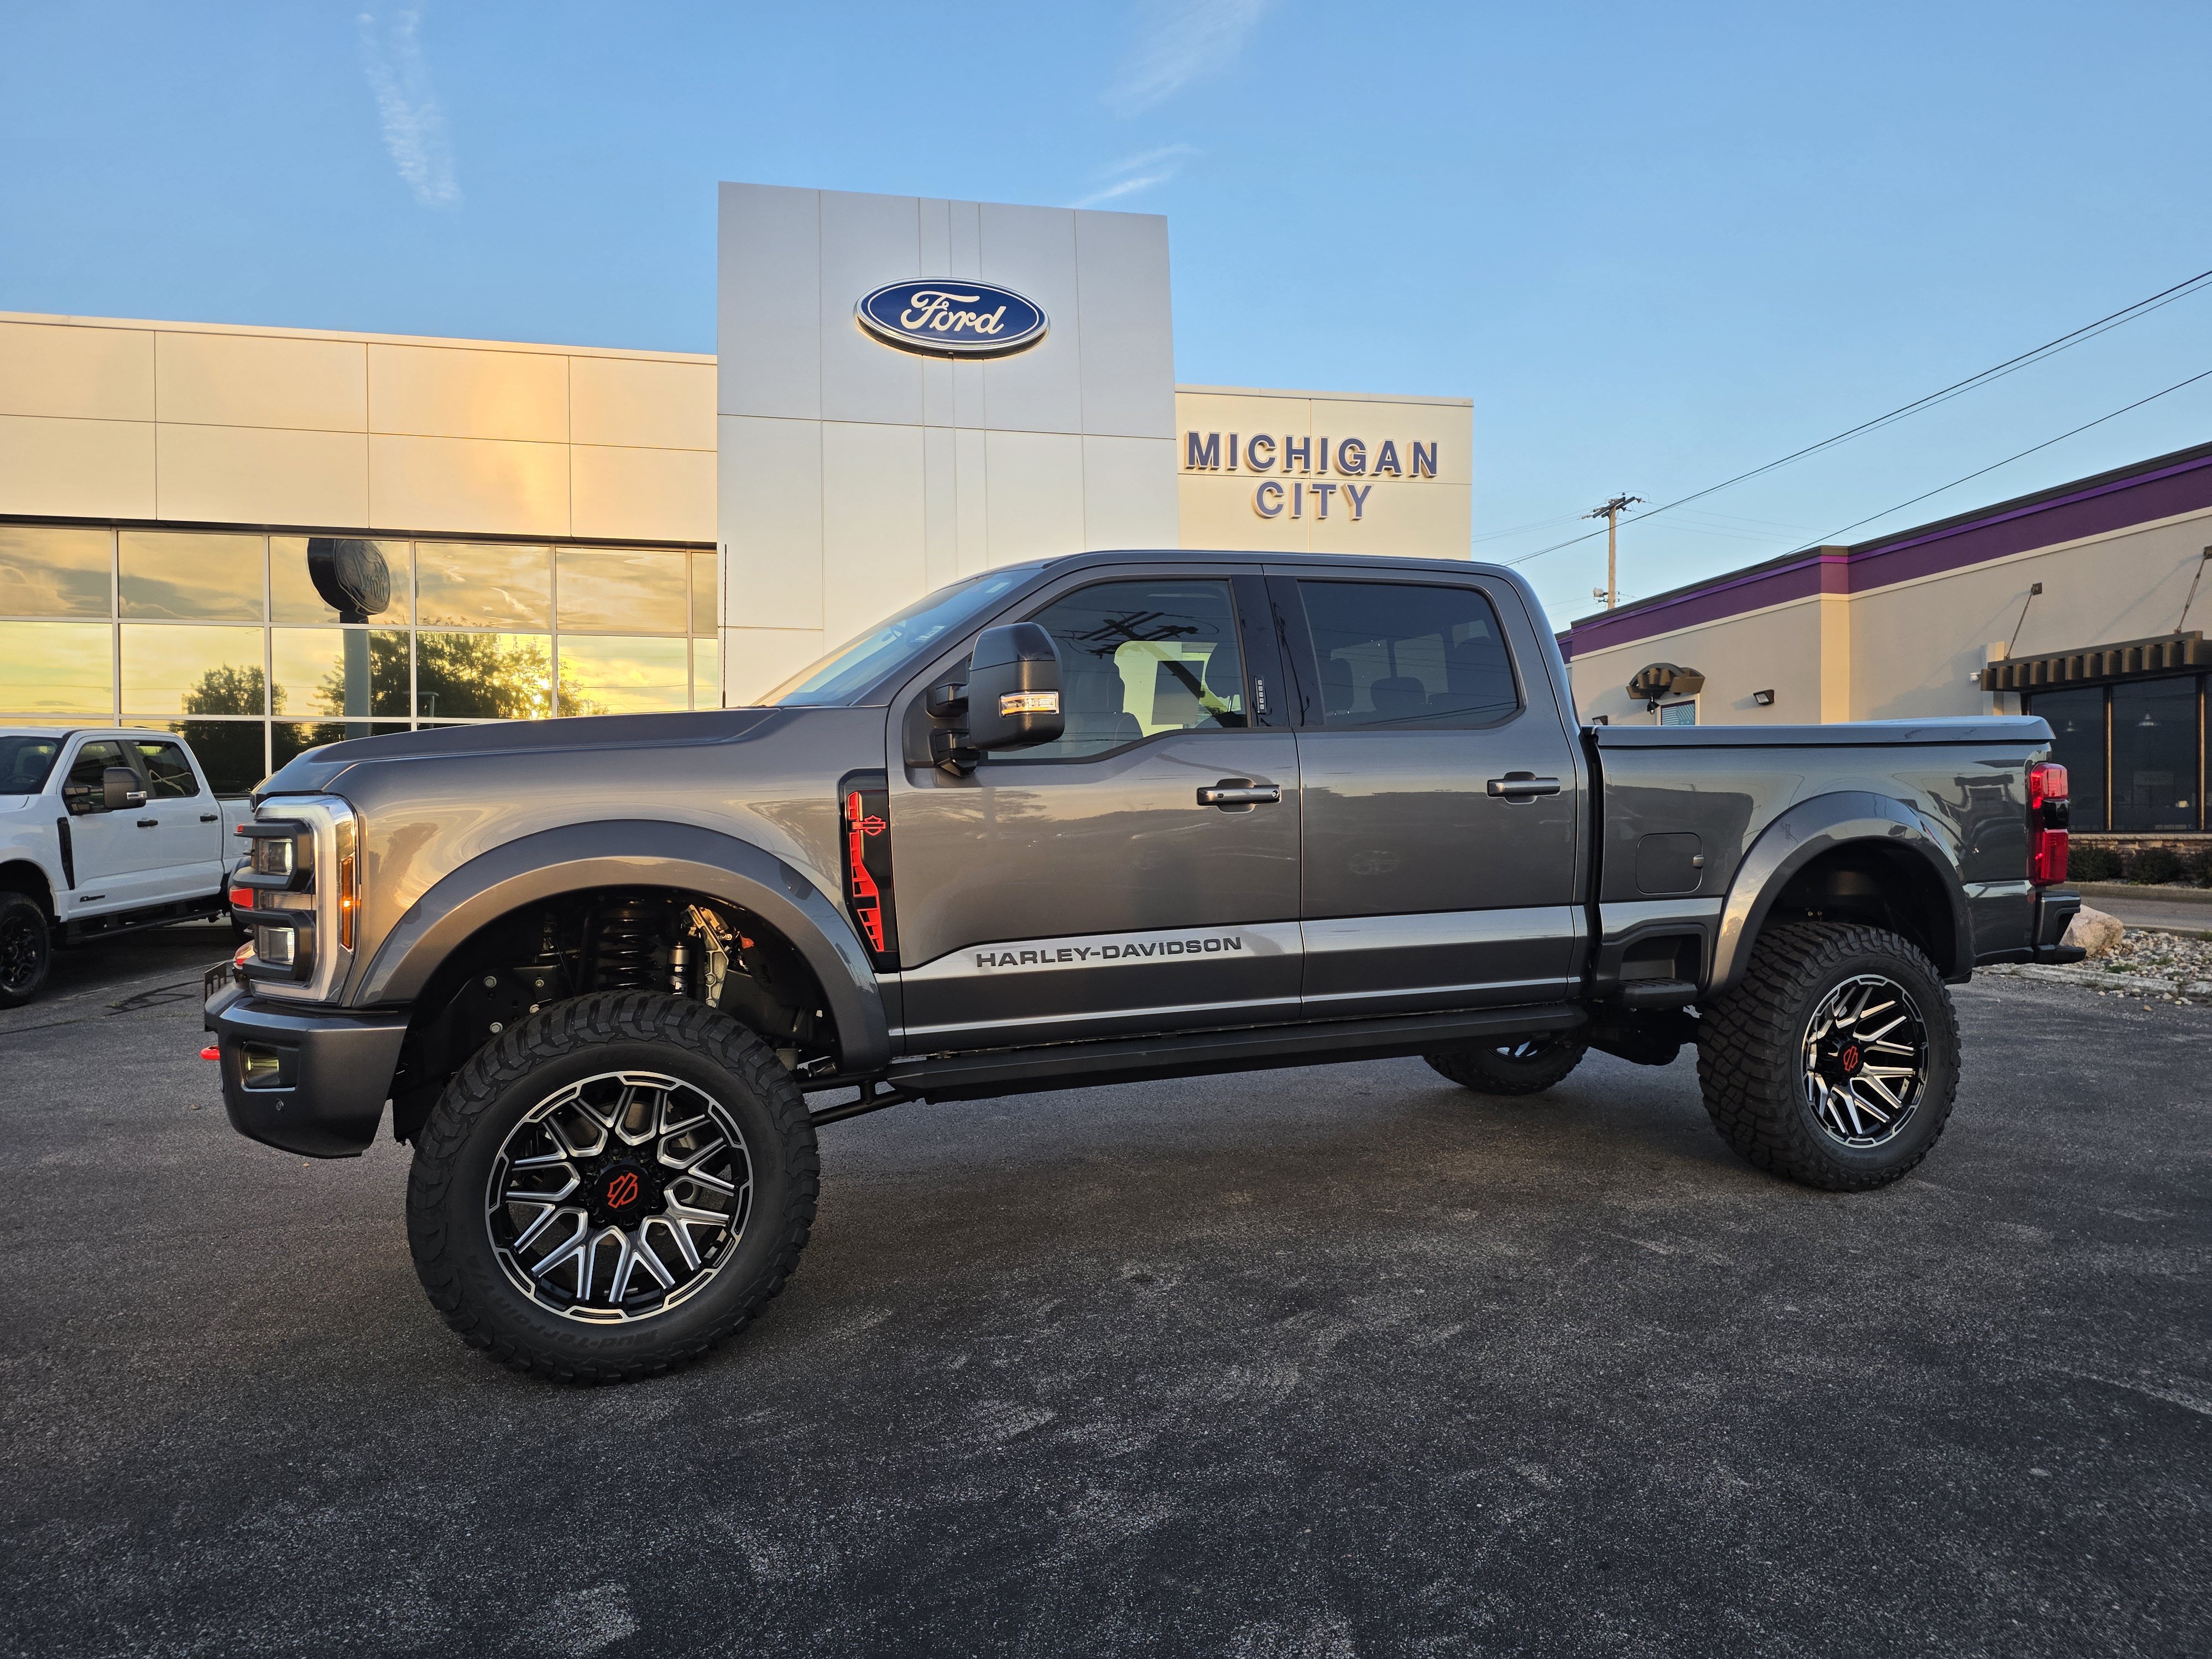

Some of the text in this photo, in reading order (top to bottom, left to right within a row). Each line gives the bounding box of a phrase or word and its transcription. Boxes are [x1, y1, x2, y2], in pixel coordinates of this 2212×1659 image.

[900, 290, 1006, 335] Ford
[1185, 431, 1439, 478] MICHIGAN
[1252, 479, 1374, 521] CITY
[975, 937, 1241, 968] HARLEY-DAVIDSON
